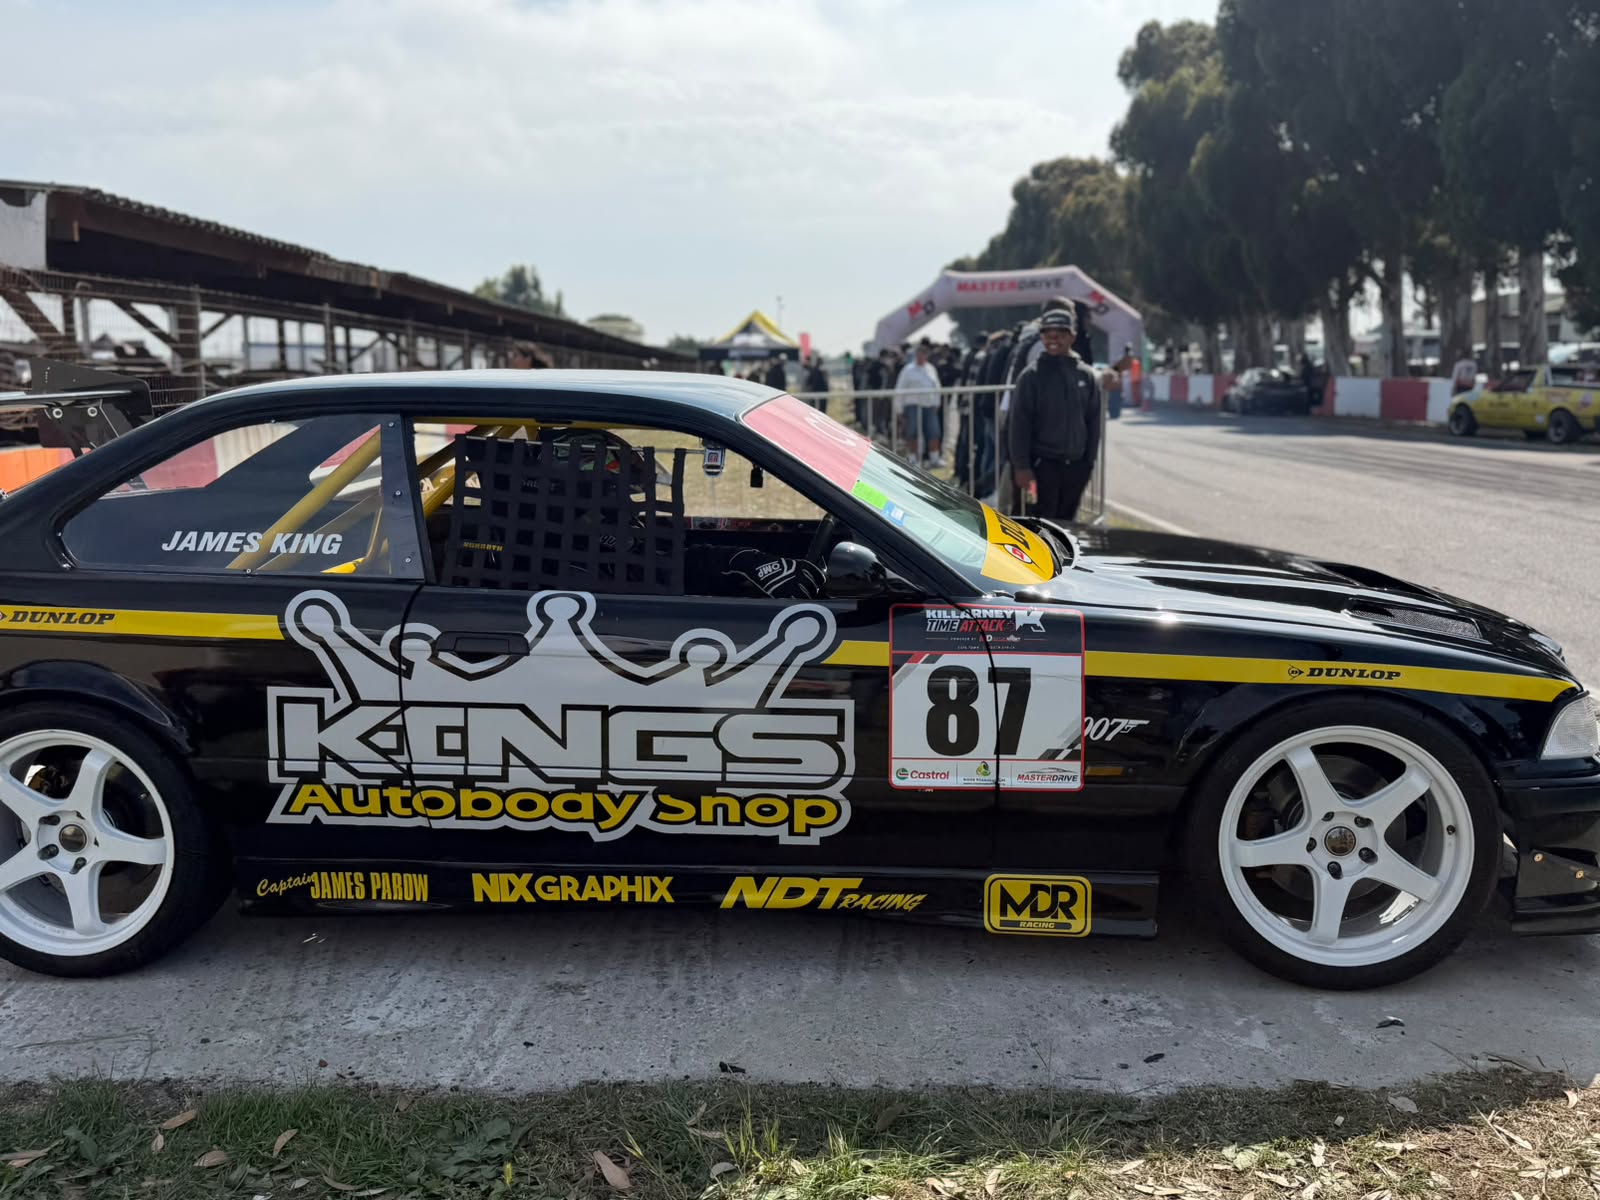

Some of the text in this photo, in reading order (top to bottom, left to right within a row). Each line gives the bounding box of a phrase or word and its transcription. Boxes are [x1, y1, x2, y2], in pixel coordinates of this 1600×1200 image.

[957, 278, 1064, 292] MASTERDRIVE
[161, 530, 343, 555] JAMES KING
[757, 563, 781, 578] OMP
[8, 610, 116, 625] DUNLOP
[925, 609, 1012, 619] KILLARNEY
[926, 619, 1004, 633] TIME ATTACK
[1306, 667, 1401, 680] DUNLOP
[926, 664, 1032, 757] 87
[281, 700, 842, 786] KINGS
[910, 770, 950, 780] Castrol
[1017, 774, 1078, 782] MASTERDRIVE
[288, 783, 641, 830] Autobody
[256, 871, 429, 902] Captain JAMES PAROW
[719, 876, 929, 913] NDT RACING
[999, 882, 1079, 920] MDR
[1019, 921, 1056, 929] RACING
